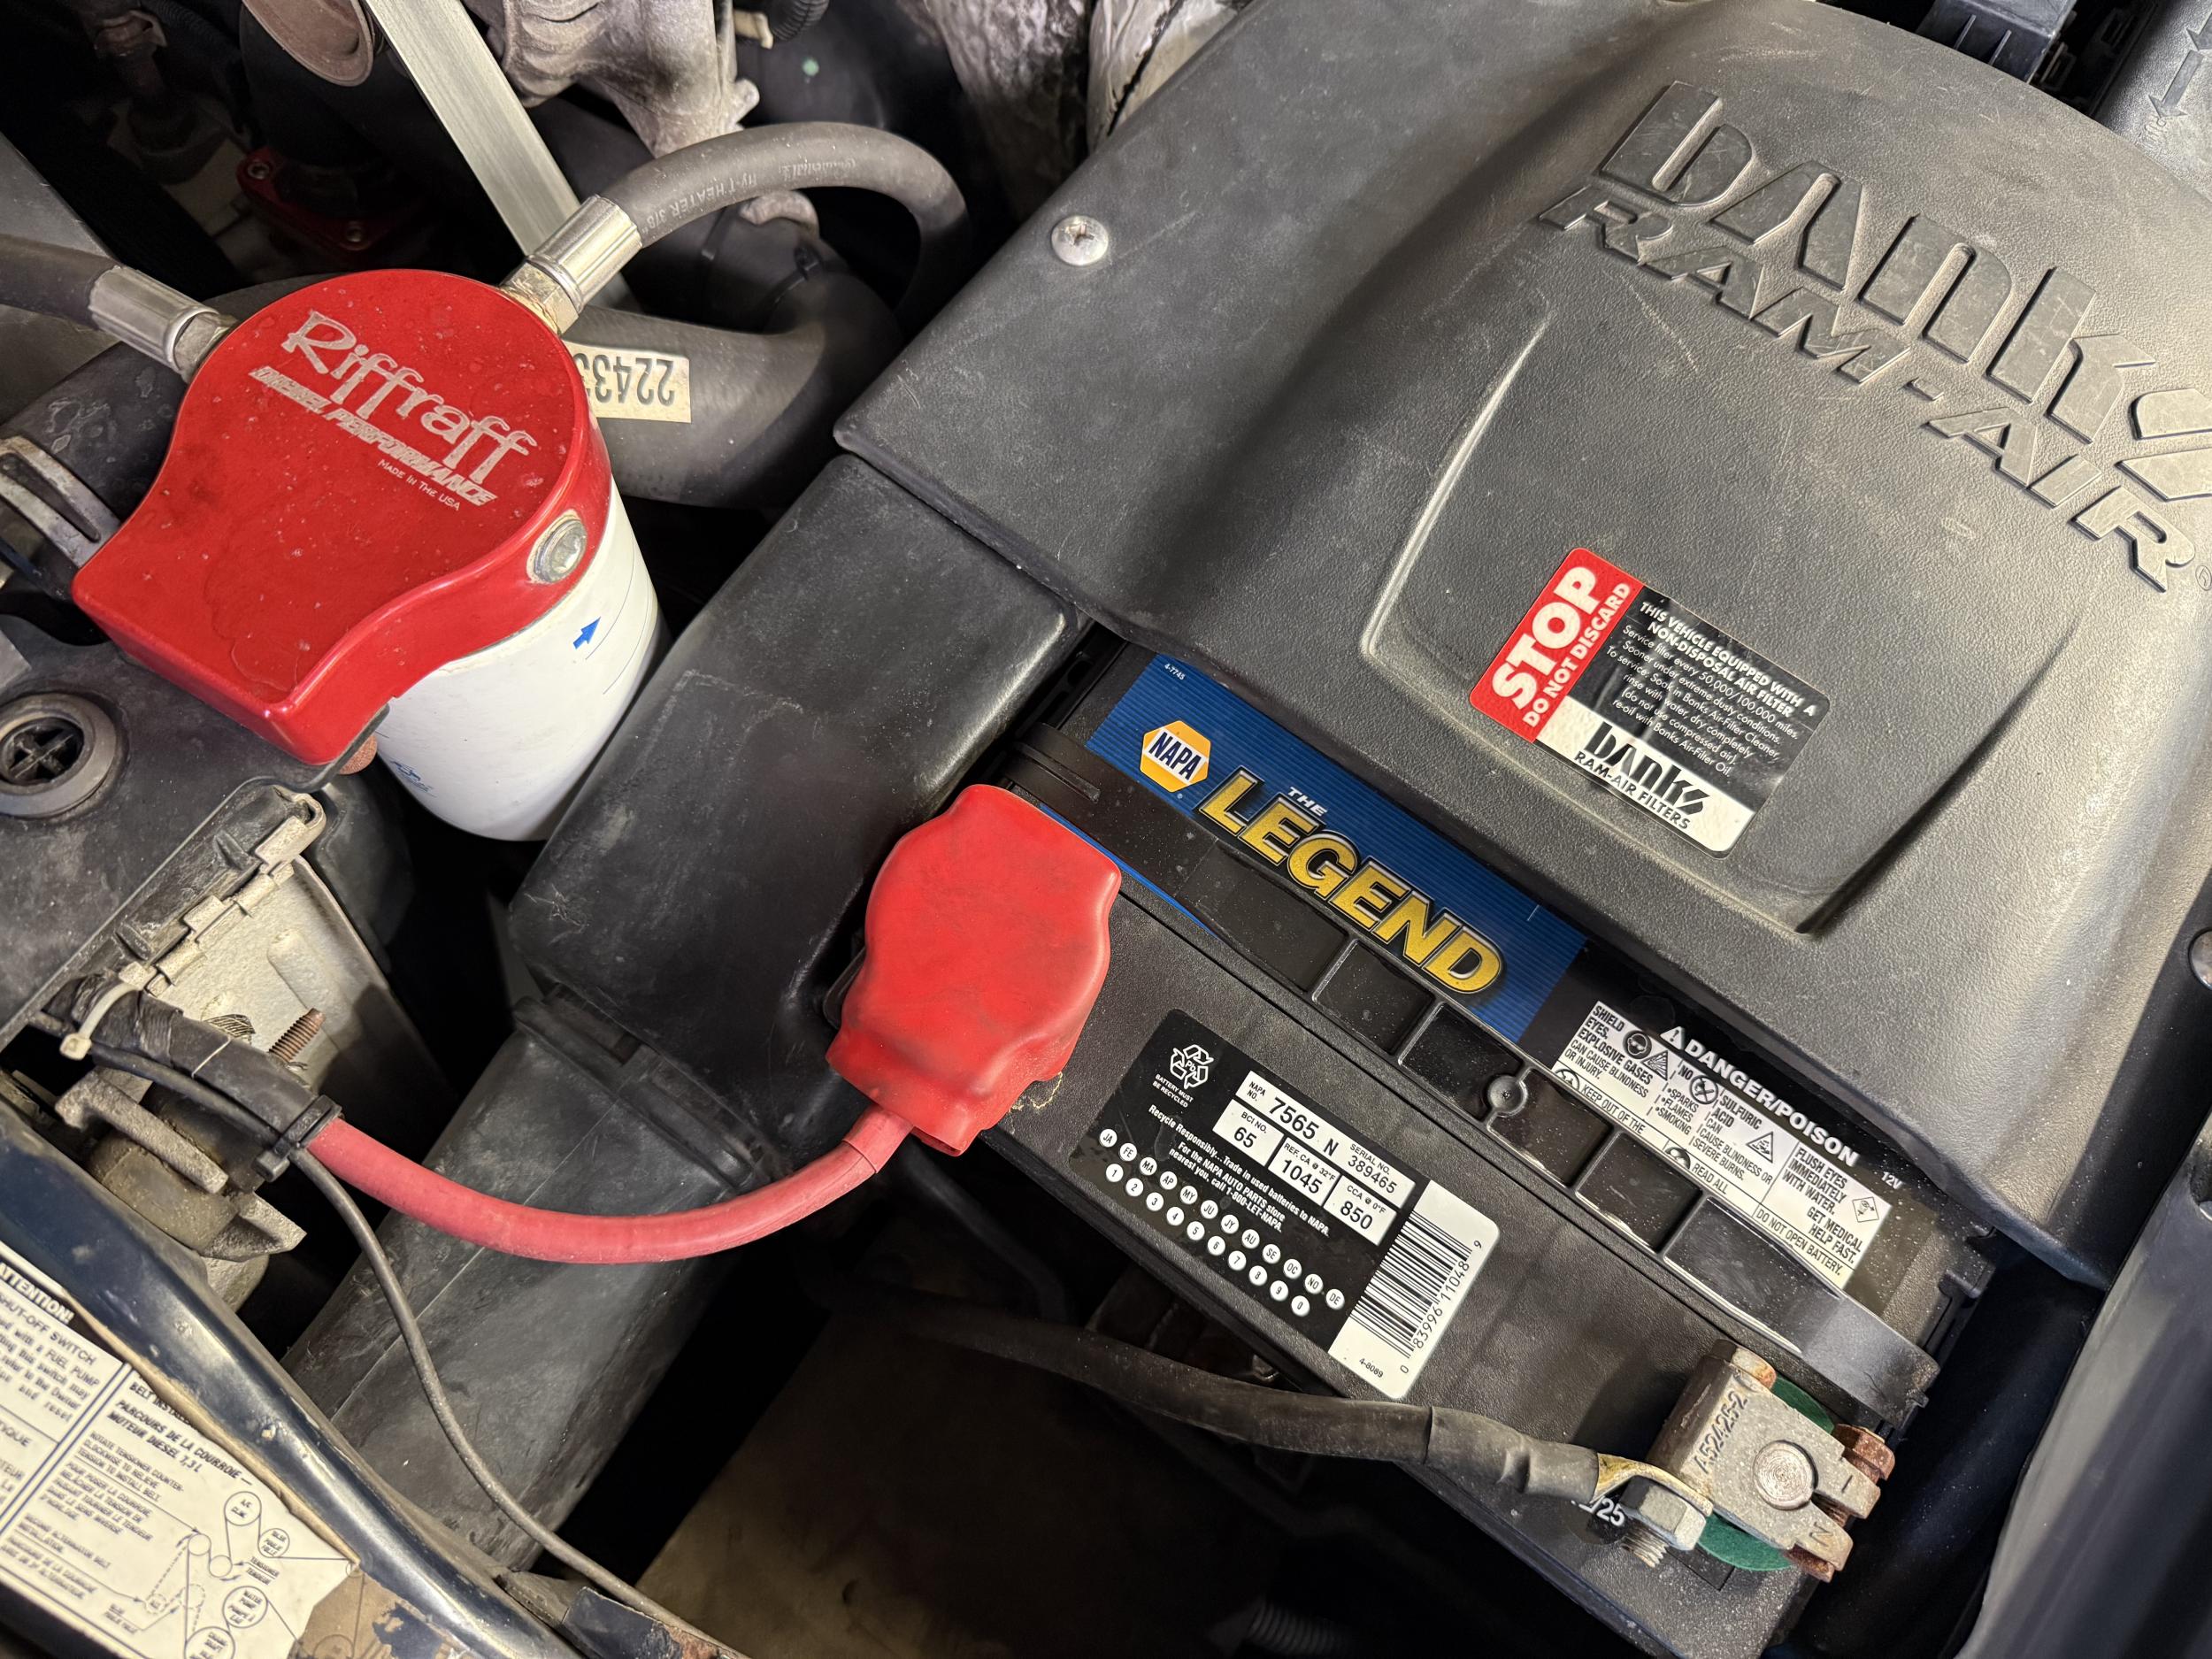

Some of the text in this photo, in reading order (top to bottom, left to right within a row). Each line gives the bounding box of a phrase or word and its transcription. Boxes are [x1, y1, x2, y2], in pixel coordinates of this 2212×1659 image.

[667, 183, 726, 215] HEATER
[281, 309, 537, 484] Riffraff
[1538, 184, 2196, 593] RAM-AIR
[248, 365, 497, 506] DIESEL PERFORMANCE
[437, 493, 460, 511] USA
[1492, 566, 1600, 716] STOP
[1522, 582, 1630, 727] DO NOT DISCARD
[1640, 601, 1816, 717] THIS VEHICLE EQUIPPED WITH A
[1622, 624, 1657, 649] Service
[1673, 657, 1699, 677] every
[1698, 671, 1777, 723] 50,000/100,000
[1774, 720, 1798, 740] miles.
[1622, 639, 1780, 745] Sooner under extreme dusty conditions.
[1647, 621, 1794, 718] NON-DISPOSAL AIR FILTER
[1622, 674, 1645, 690] rinse
[1644, 687, 1663, 701] with
[1689, 714, 1708, 729] dry
[1706, 726, 1755, 759] completely
[1637, 699, 1655, 711] not
[1653, 708, 1669, 721] use
[1668, 718, 1722, 753] compressed
[1649, 672, 1675, 694] Soak
[1681, 692, 1709, 714] Banks
[1707, 710, 1746, 735] Air-Filter
[1149, 732, 1202, 780] NAPA
[1611, 699, 1732, 777] re-oil with Banks Air-Filter Oil.
[1287, 786, 1327, 817] THE
[1573, 750, 1691, 829] RAM-AIR FILTERS
[1194, 764, 1505, 994] LEGEND
[1577, 1026, 1653, 1085] EXPLOSIVE GASES
[1592, 1004, 1694, 1080] SHIELD NO
[1155, 1073, 1194, 1102] BATTERY MUST
[1570, 1039, 1648, 1098] CAN CAUSE BLINDNESS
[1574, 1055, 1602, 1079] INJURY.
[1159, 1085, 1188, 1108] RECYCLED
[1246, 1088, 1257, 1102] NO.
[1578, 1083, 1646, 1134] KEEP OUT THE
[1684, 1038, 1859, 1167] DANGER/POISON
[1710, 1106, 1734, 1128] ACID
[1718, 1094, 1763, 1130] SULFURIC
[1233, 1126, 1257, 1148] 65
[1240, 1110, 1267, 1133] BCI NO.
[1248, 1080, 1390, 1175] NAPA 7565 N SERIAL NO.
[1705, 1118, 1723, 1134] CAN
[1148, 1103, 1329, 1237] Recycle used batteries NAPA.
[1168, 1148, 1196, 1171] nearest
[1193, 1165, 1210, 1182] you,
[1210, 1177, 1226, 1191] call
[1283, 1142, 1300, 1157] REF.
[1692, 1137, 1722, 1163] SEVERE
[1699, 1127, 1763, 1177] CAUSE BLINDNESS
[1794, 1147, 1847, 1189] FLUSH EYES
[1177, 1141, 1286, 1222] For the NAPA AUTO PARTS store
[1281, 1159, 1323, 1194] 1045
[1346, 1184, 1363, 1200] CCA
[1347, 1155, 1397, 1194] 389465
[1691, 1162, 1728, 1194] READ ALL
[1781, 1168, 1835, 1215] WITH WATER.
[1787, 1157, 1847, 1203] IMMEDIATELY
[1880, 1171, 1902, 1189] 12V
[1340, 1200, 1373, 1230] 850
[1806, 1205, 1863, 1253] GET MEDICAL
[1755, 1208, 1843, 1276] DO NOT OPEN BATTERY.
[1808, 1223, 1856, 1264] HELP FAST.
[0, 1263, 74, 1324] ATTENTION!
[1440, 1261, 1470, 1301] 11048
[49, 1331, 96, 1365] SWITCH
[1413, 1307, 1443, 1349] 83996
[45, 1349, 100, 1387] FUEL PUMP
[1358, 1357, 1384, 1378] 4-8089
[1571, 1496, 1624, 1525] /25
